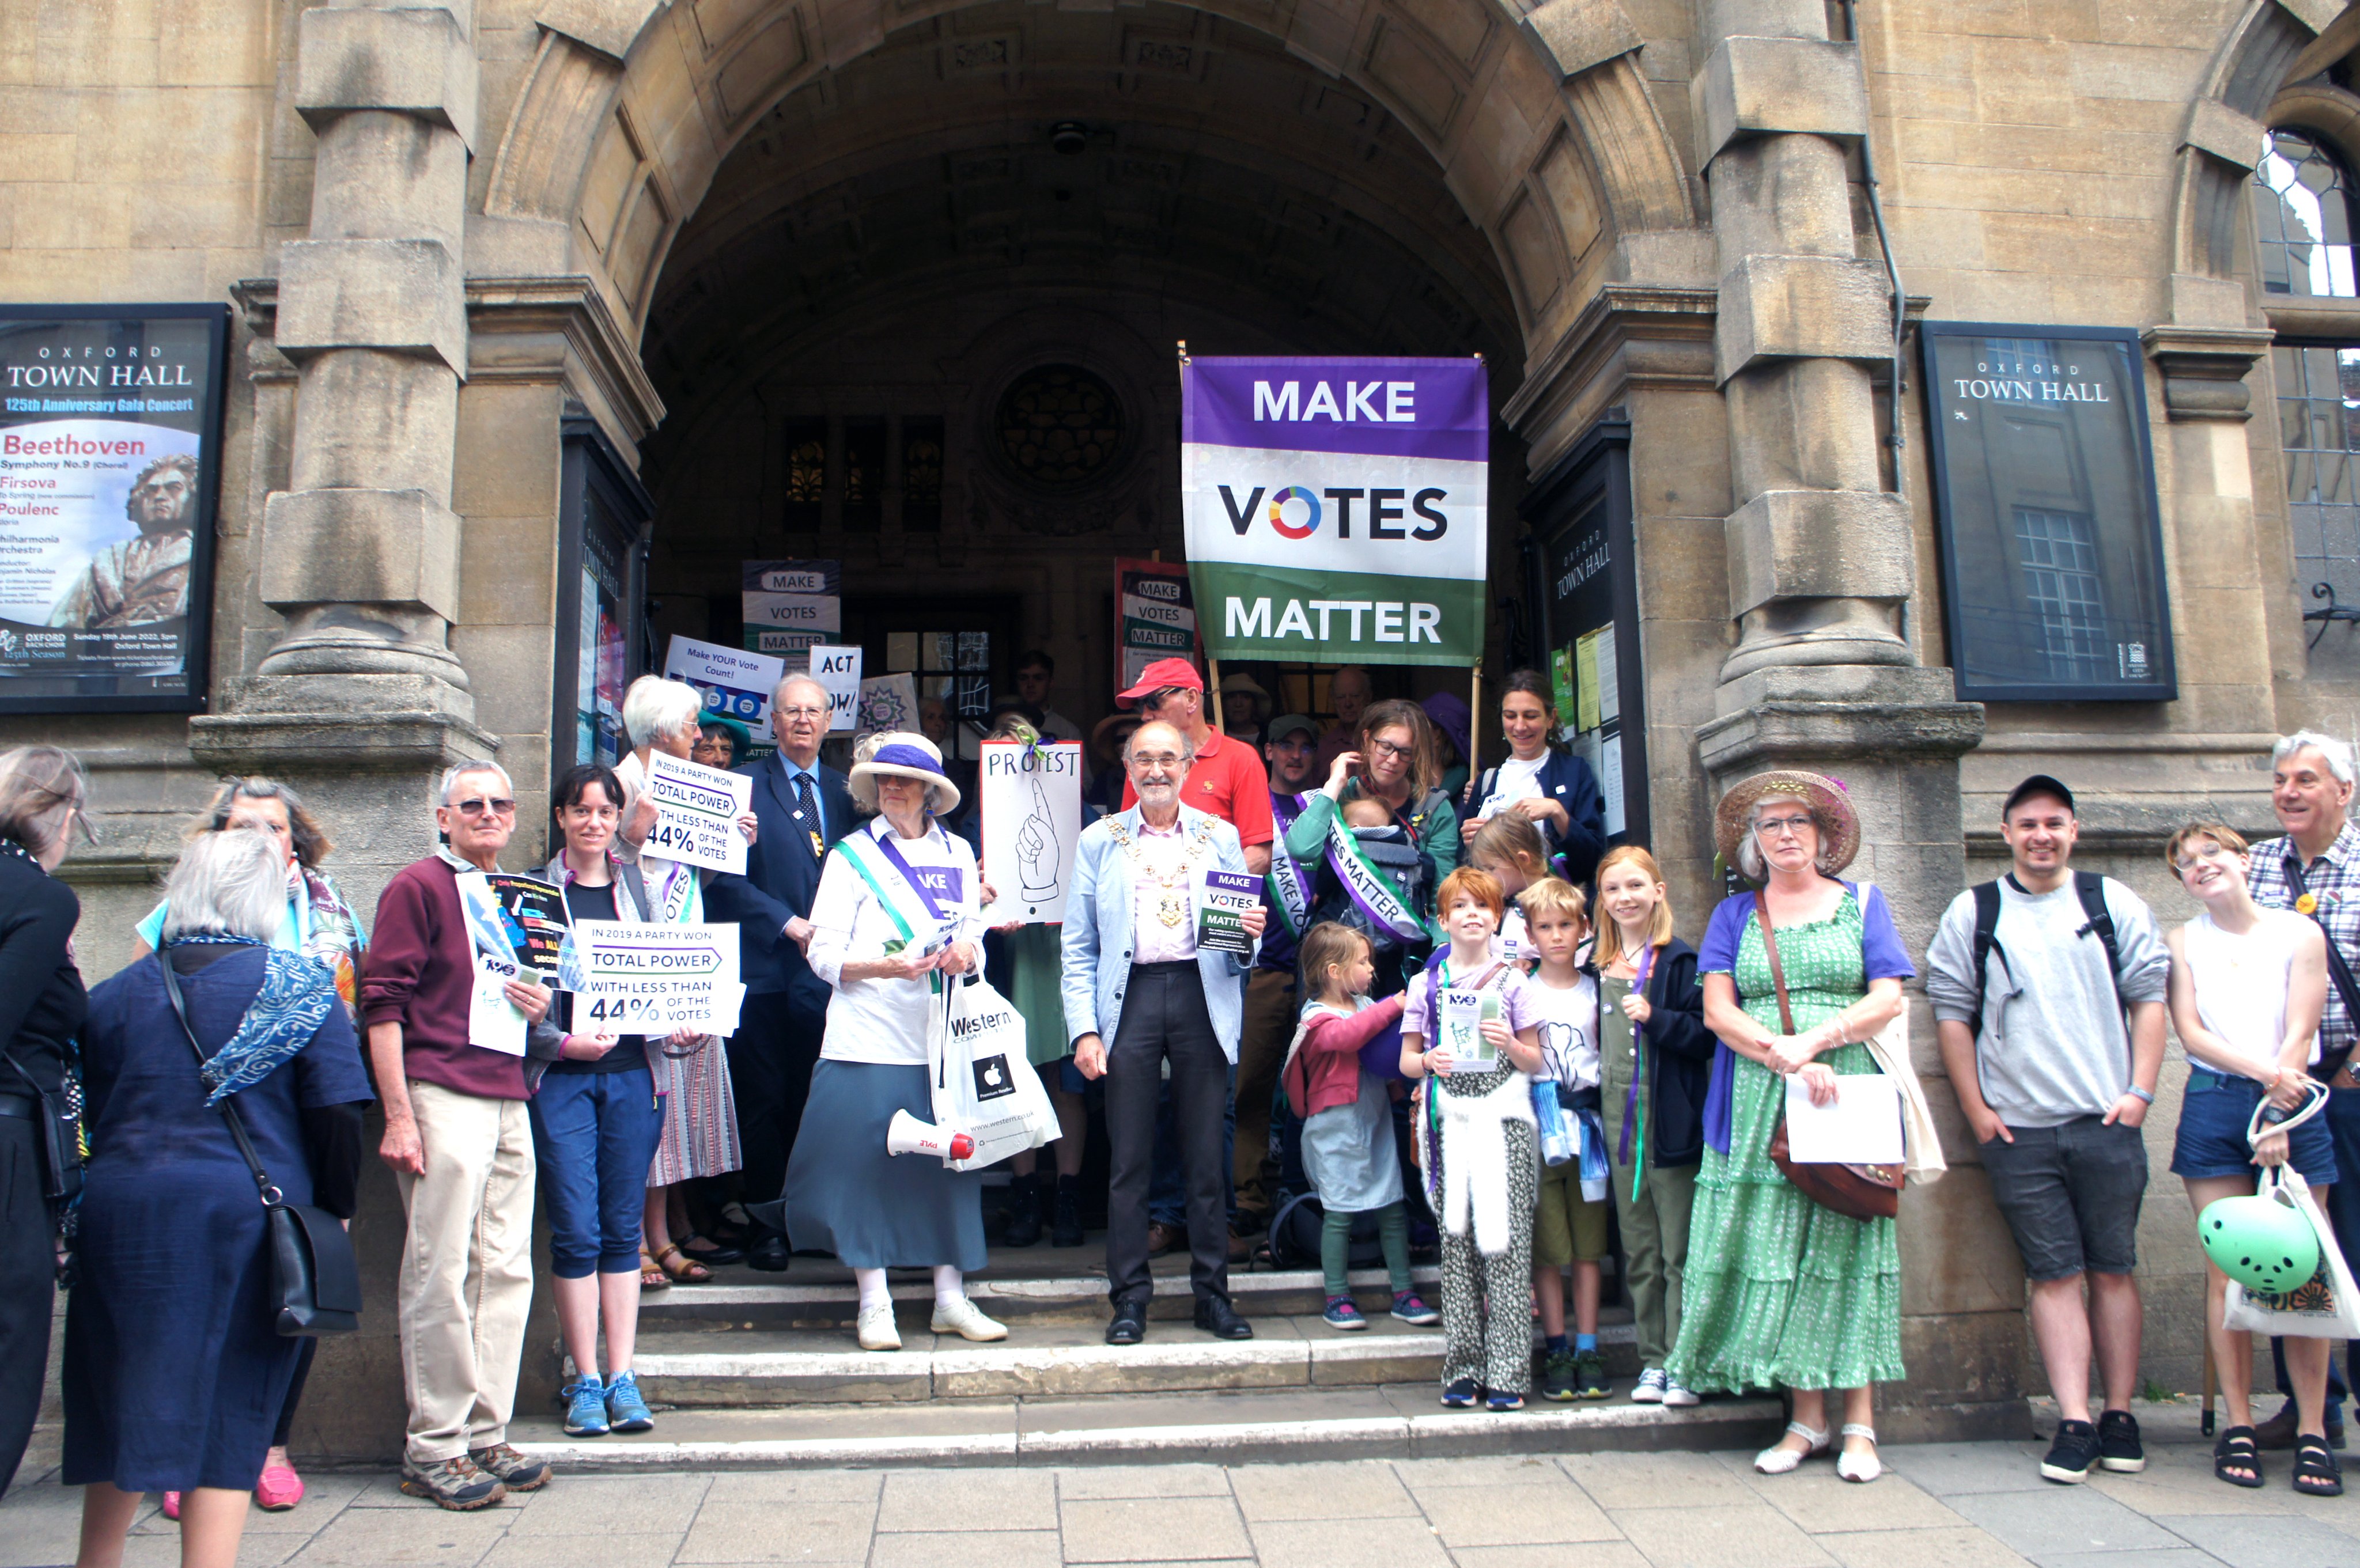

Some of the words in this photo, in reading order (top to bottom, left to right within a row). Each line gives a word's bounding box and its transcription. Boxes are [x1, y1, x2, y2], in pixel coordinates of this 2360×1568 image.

[40, 347, 161, 358] OXFORD
[8, 366, 100, 387] TOWN
[110, 365, 192, 387] HALL
[1977, 362, 2078, 375] OXFORD
[1954, 380, 2032, 399] TOWN
[2040, 381, 2109, 402] HALL
[5, 398, 40, 412] 125th
[43, 399, 115, 413] Anniversary
[118, 398, 144, 411] Gala
[147, 398, 194, 411] Concert
[1253, 381, 1416, 422] MAKE
[4, 434, 145, 456] Beethoven
[1, 460, 59, 470] Symphony
[0, 476, 56, 489] Firsova
[0, 502, 59, 515] Poulenc
[1217, 484, 1448, 541] VOTES
[0, 534, 60, 543] hilharmonia
[0, 546, 43, 554] rchestra
[1564, 529, 1599, 566] OXFORD
[1557, 563, 1584, 600] TOWN
[1585, 541, 1611, 578] HALL
[602, 565, 619, 602] HALL
[773, 576, 815, 588] MAKE
[1141, 583, 1177, 597] MAKE
[770, 607, 816, 619] VOTES
[1139, 607, 1179, 621] VOTES
[1226, 597, 1442, 643] MATTER
[25, 633, 66, 642] OXFORD
[764, 636, 822, 649] MATTER
[1133, 630, 1184, 645] MATTER
[32, 649, 66, 658] Season
[687, 648, 710, 660] Make
[712, 654, 737, 666] YOUR
[739, 660, 759, 671] Vote
[821, 655, 854, 673] ACT
[705, 665, 735, 679] Count!
[830, 691, 857, 717] OW!
[656, 759, 663, 768] IN
[663, 762, 679, 774] 2019
[687, 769, 712, 781] PARTY
[713, 775, 732, 787] WON
[652, 781, 687, 801] TOTAL
[690, 791, 729, 812] POWER
[660, 809, 674, 821] TH
[676, 813, 700, 827] LESS
[702, 820, 728, 835] THAN
[646, 823, 694, 853] 44%
[698, 834, 709, 842] OF
[711, 836, 727, 847] THE
[698, 845, 727, 861] VOTES
[1327, 820, 1345, 860] TES
[1344, 857, 1399, 922] MATTER
[1218, 875, 1251, 888] MAKE
[1272, 857, 1299, 902] MAKE
[665, 872, 689, 921] OTES
[1210, 893, 1253, 909] VOTES
[1207, 914, 1242, 927] MATTE
[592, 929, 603, 937] IN
[606, 930, 632, 939] 2019
[635, 931, 642, 939] A
[645, 931, 680, 940] PARTY
[684, 932, 712, 940] WON
[528, 938, 544, 949] We
[592, 953, 646, 967] TOTAL
[651, 955, 711, 967] POWER
[591, 982, 629, 993] WITH
[633, 982, 667, 993] LESS
[671, 981, 712, 992] THAN
[589, 998, 660, 1021] 44%
[667, 998, 683, 1007] OF
[687, 997, 711, 1006] THE
[667, 1009, 712, 1021] VOTES
[951, 1012, 1012, 1037] Western
[979, 1090, 998, 1099] Premium
[970, 1110, 1034, 1133] www.western.co.uk
